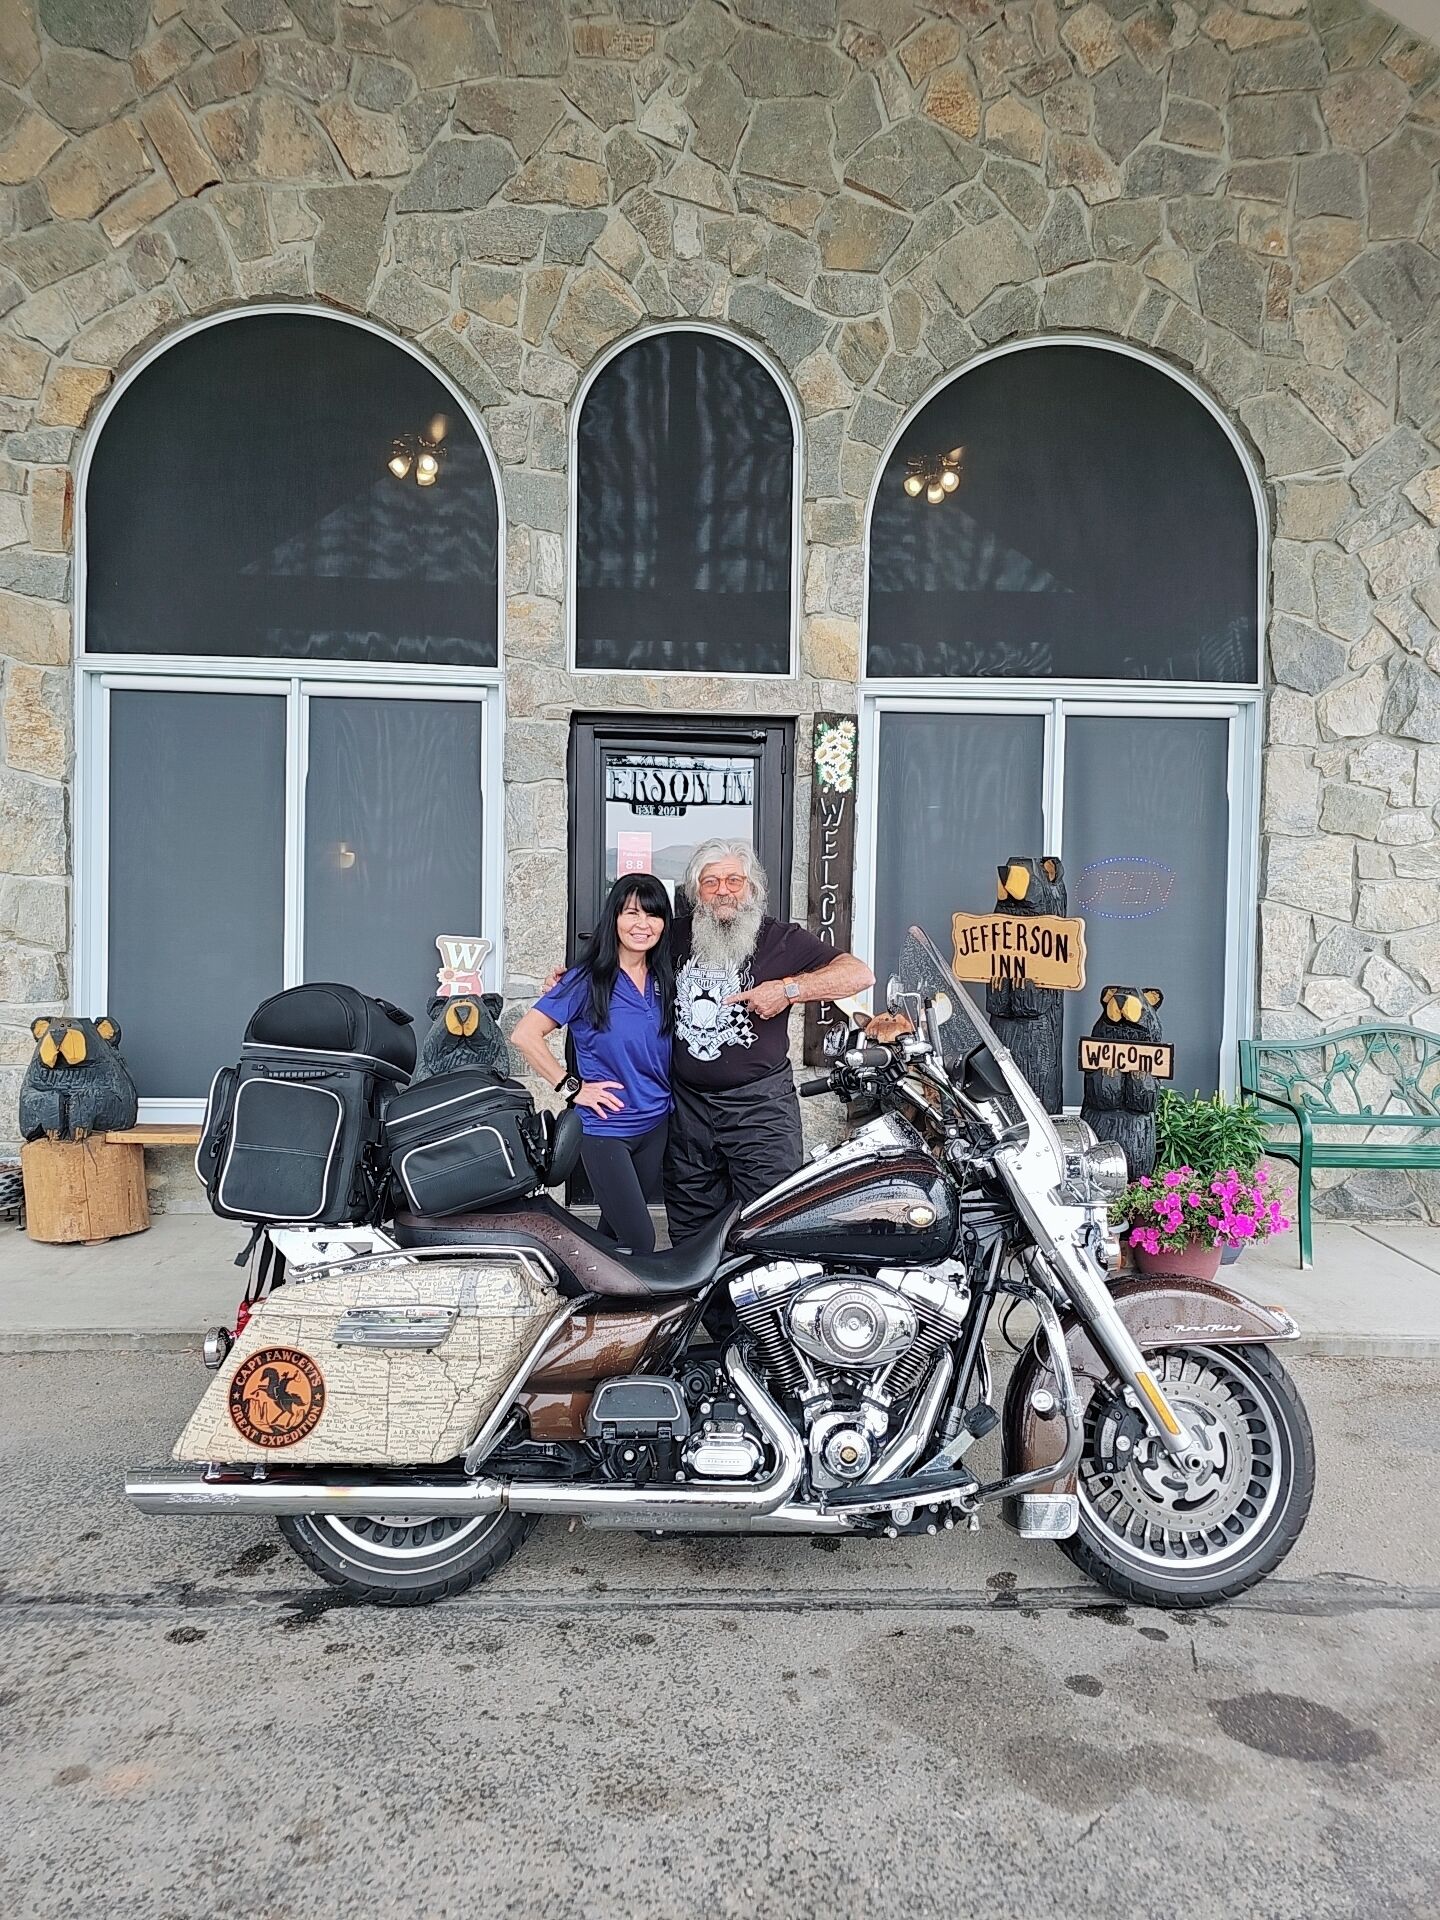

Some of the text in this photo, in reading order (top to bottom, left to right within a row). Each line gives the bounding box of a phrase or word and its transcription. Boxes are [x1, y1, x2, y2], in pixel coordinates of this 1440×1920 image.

[657, 805, 681, 817] 2021
[625, 860, 644, 870] 8.8
[1074, 871, 1177, 905] OPEN
[817, 796, 846, 1026] WELCOE
[959, 921, 1069, 964] JEFFERSON
[991, 954, 1026, 979] INN
[235, 1355, 263, 1386] CAPT
[231, 1404, 260, 1440] GREAT
[259, 1405, 323, 1446] EXPEDITION
